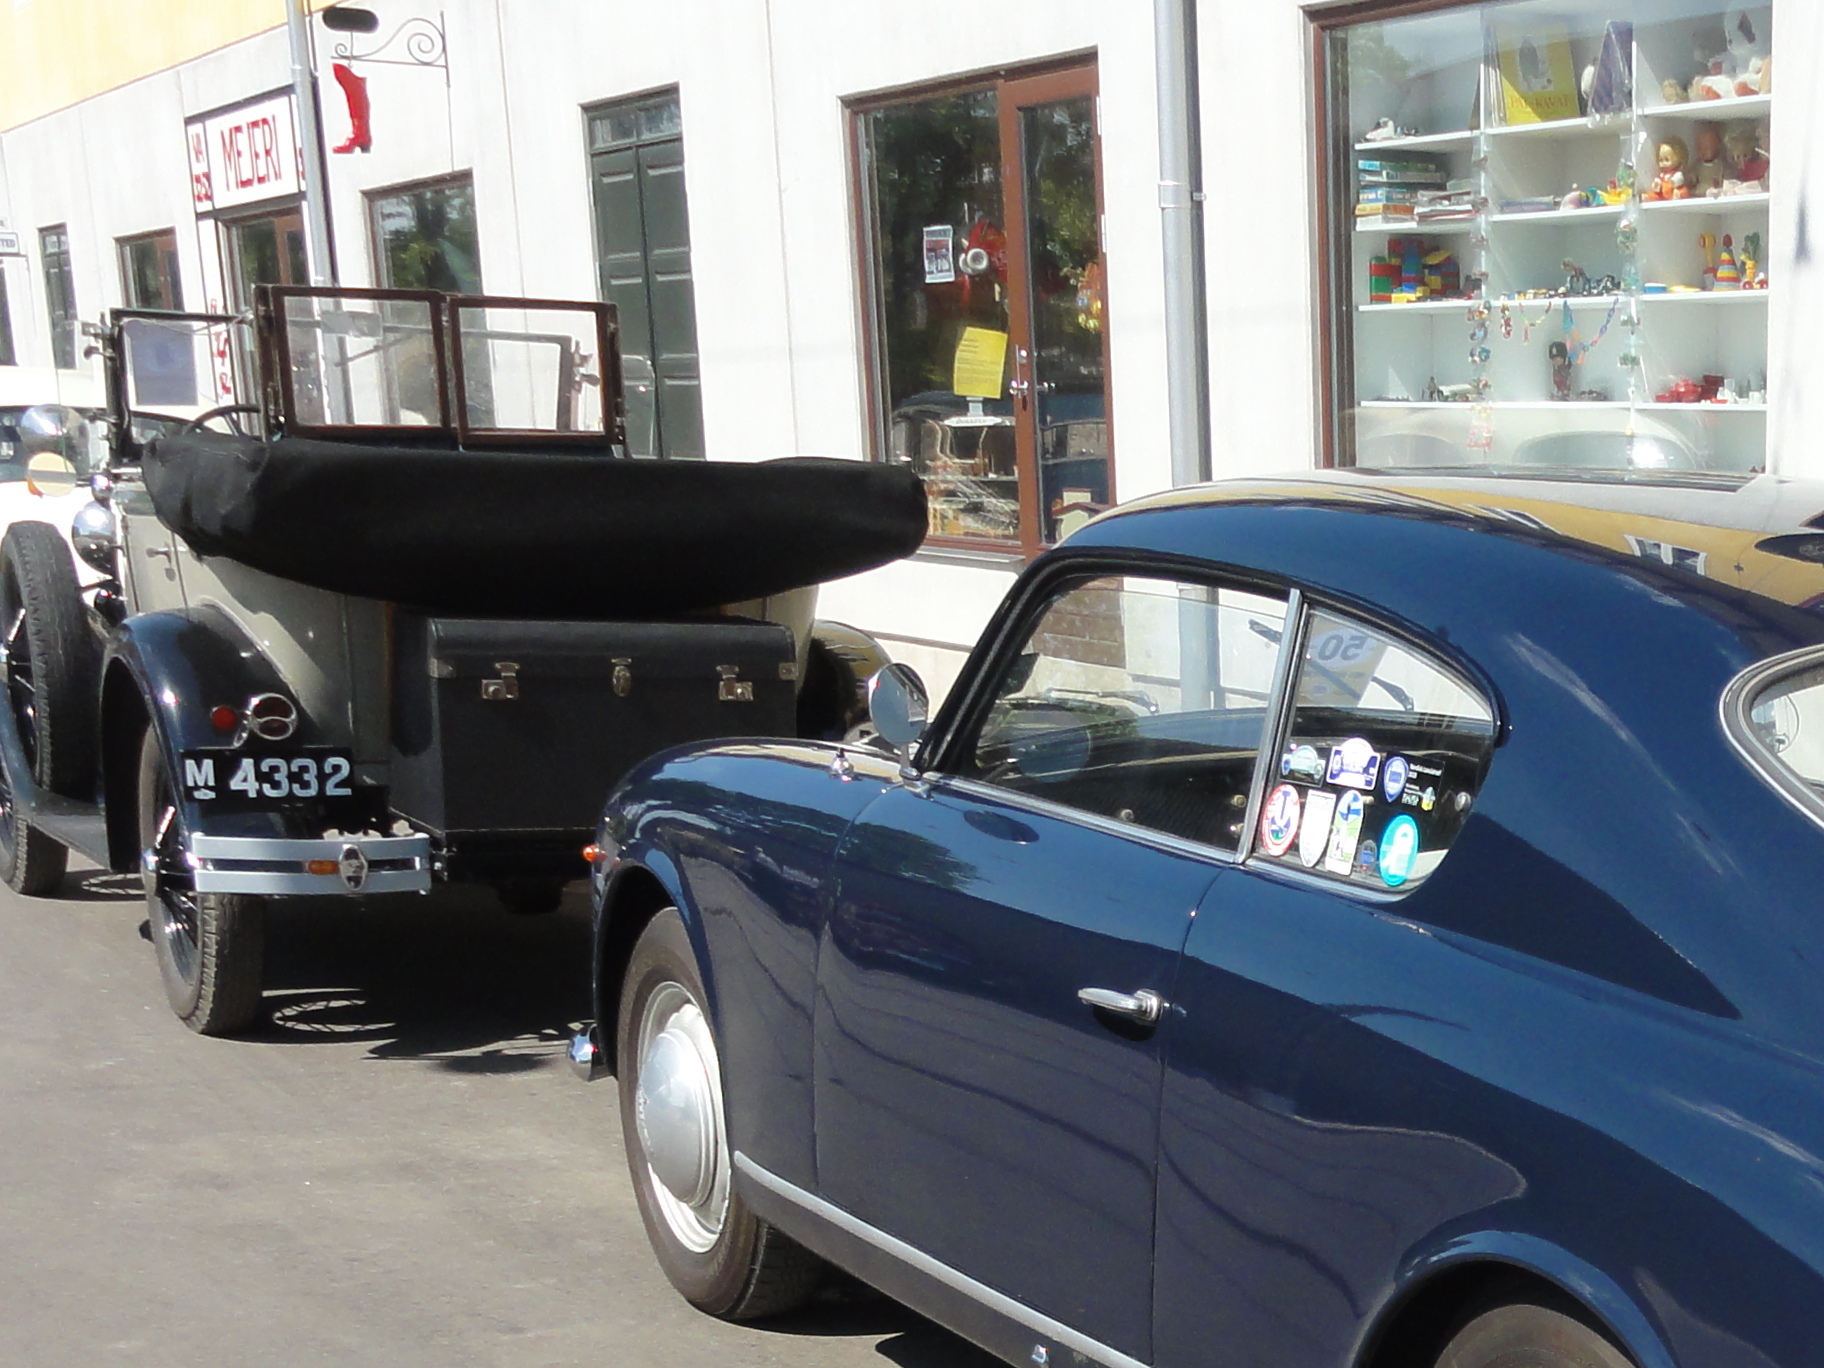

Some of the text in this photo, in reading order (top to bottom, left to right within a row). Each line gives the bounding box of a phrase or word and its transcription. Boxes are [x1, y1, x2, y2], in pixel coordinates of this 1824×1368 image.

[220, 114, 282, 191] MEJERI
[185, 756, 352, 798] M 4332
